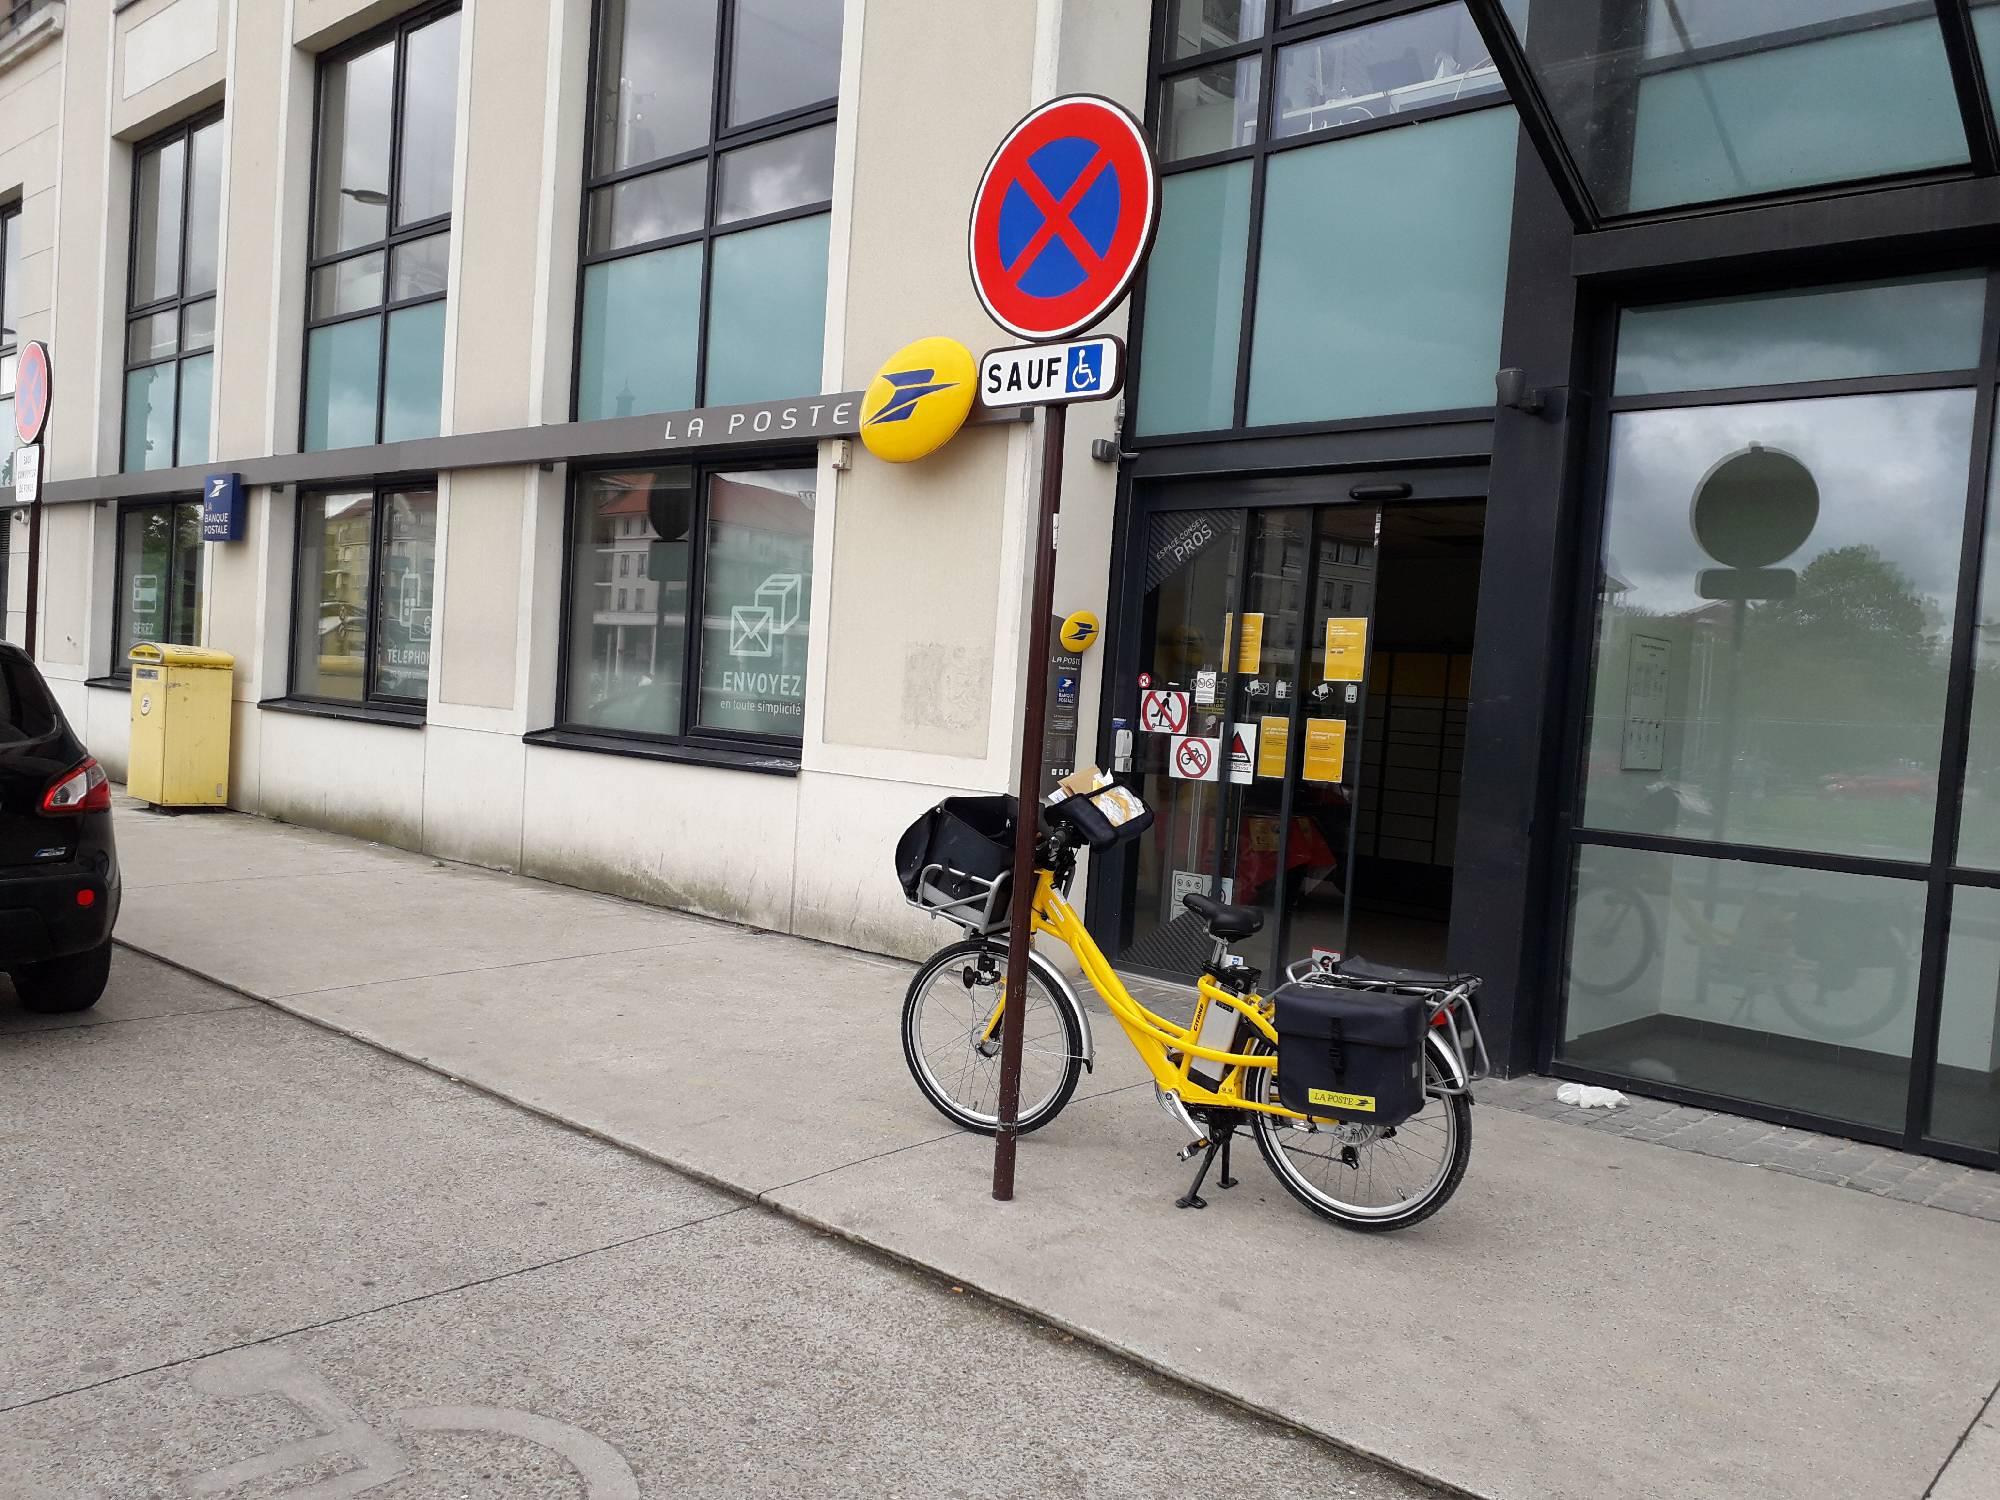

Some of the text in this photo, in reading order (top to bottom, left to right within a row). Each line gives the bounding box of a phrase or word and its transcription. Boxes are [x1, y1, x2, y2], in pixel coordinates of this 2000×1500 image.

[987, 357, 1061, 394] SAUF
[664, 402, 853, 440] LA POSTE
[204, 501, 213, 512] LA
[204, 512, 229, 523] BANQUE
[203, 524, 229, 535] POSTALE
[1156, 515, 1207, 560] ESPACE CONSEIL
[1173, 524, 1212, 562] PROS
[1051, 655, 1062, 663] LA
[722, 671, 802, 696] ENVOYEZ
[720, 700, 801, 716] en toute simplicité
[1314, 1092, 1354, 1106] LA POSTE
